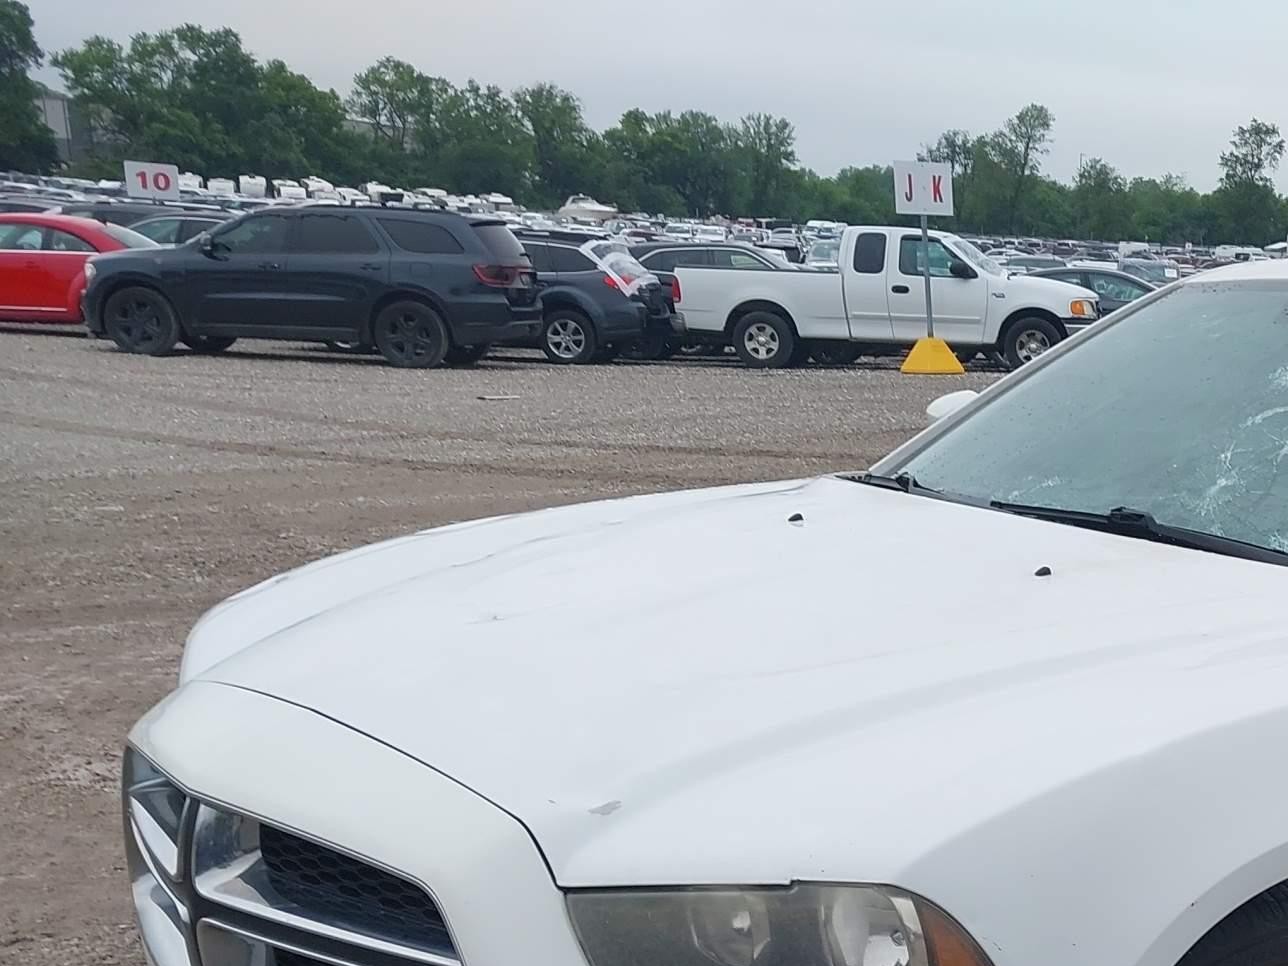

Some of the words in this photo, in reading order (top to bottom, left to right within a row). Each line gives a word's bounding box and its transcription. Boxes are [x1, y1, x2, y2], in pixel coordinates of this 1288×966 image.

[135, 170, 170, 191] 10
[905, 173, 913, 203] J
[932, 174, 944, 203] K
